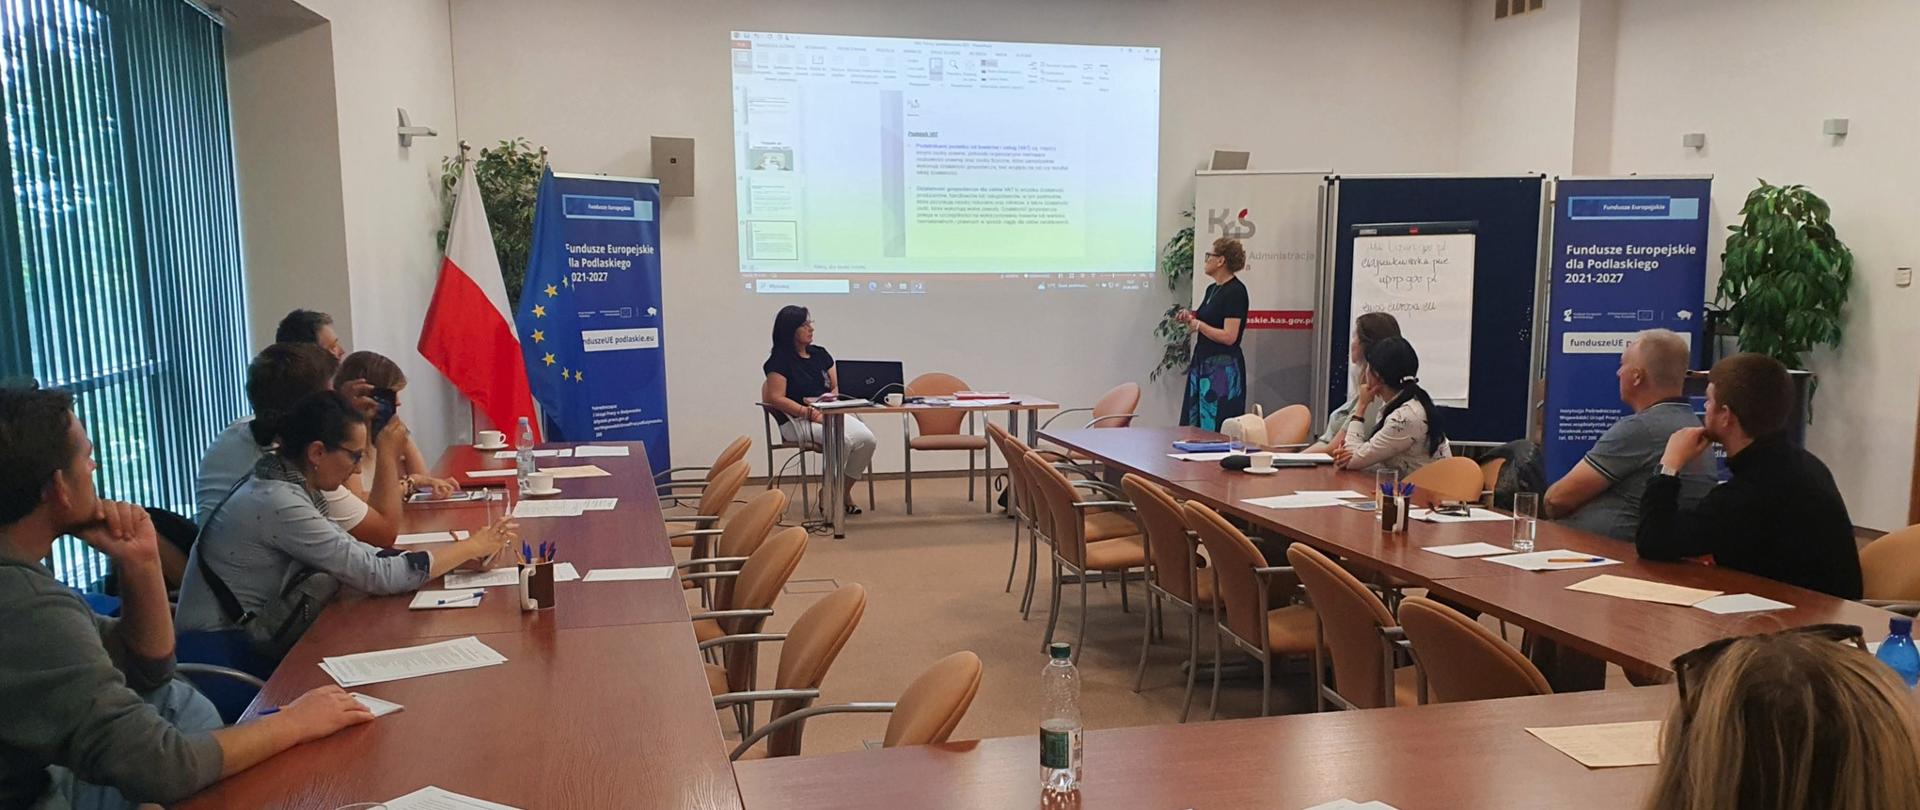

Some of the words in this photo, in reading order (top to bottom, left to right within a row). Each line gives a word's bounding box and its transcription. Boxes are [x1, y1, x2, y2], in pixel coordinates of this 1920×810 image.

[1631, 204, 1666, 212] Europejskie
[607, 244, 655, 257] Europejskie
[1566, 244, 1623, 256] Fundusze
[1626, 244, 1697, 258] Europejskie
[581, 258, 632, 271] Podlaskiego
[1565, 259, 1584, 270] dla
[1587, 259, 1659, 271] Podlaskiego
[571, 272, 608, 282] 021-2027
[1565, 273, 1624, 284] 2021-2027
[1570, 338, 1623, 348] funduszeUE
